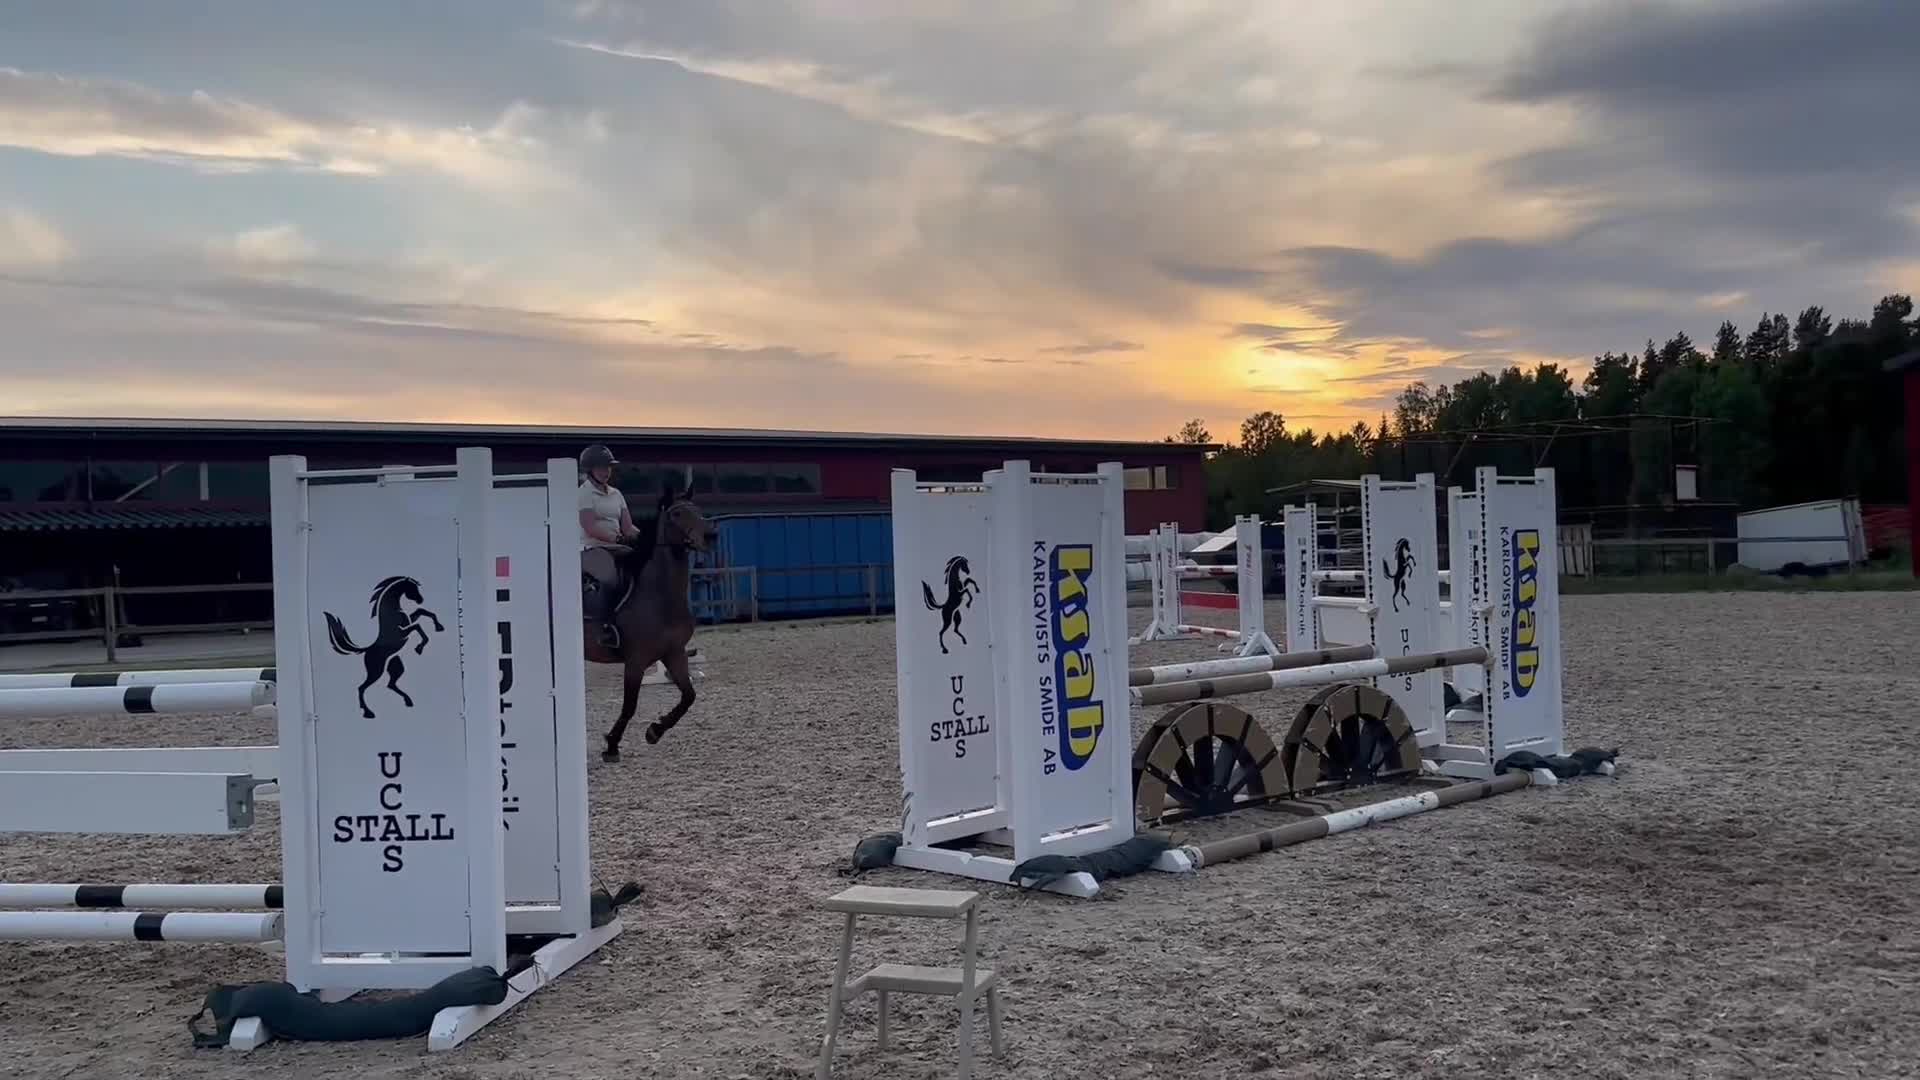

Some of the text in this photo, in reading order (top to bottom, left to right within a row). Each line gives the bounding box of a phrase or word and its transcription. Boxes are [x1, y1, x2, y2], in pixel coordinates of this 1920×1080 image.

[1500, 526, 1512, 618] KARLQVISTS
[1033, 540, 1056, 775] KARLQVISTS SMIDE AB
[1050, 544, 1104, 771] ksab
[1502, 681, 1511, 700] AB
[930, 715, 989, 742] STALL
[333, 814, 454, 842] STALL
